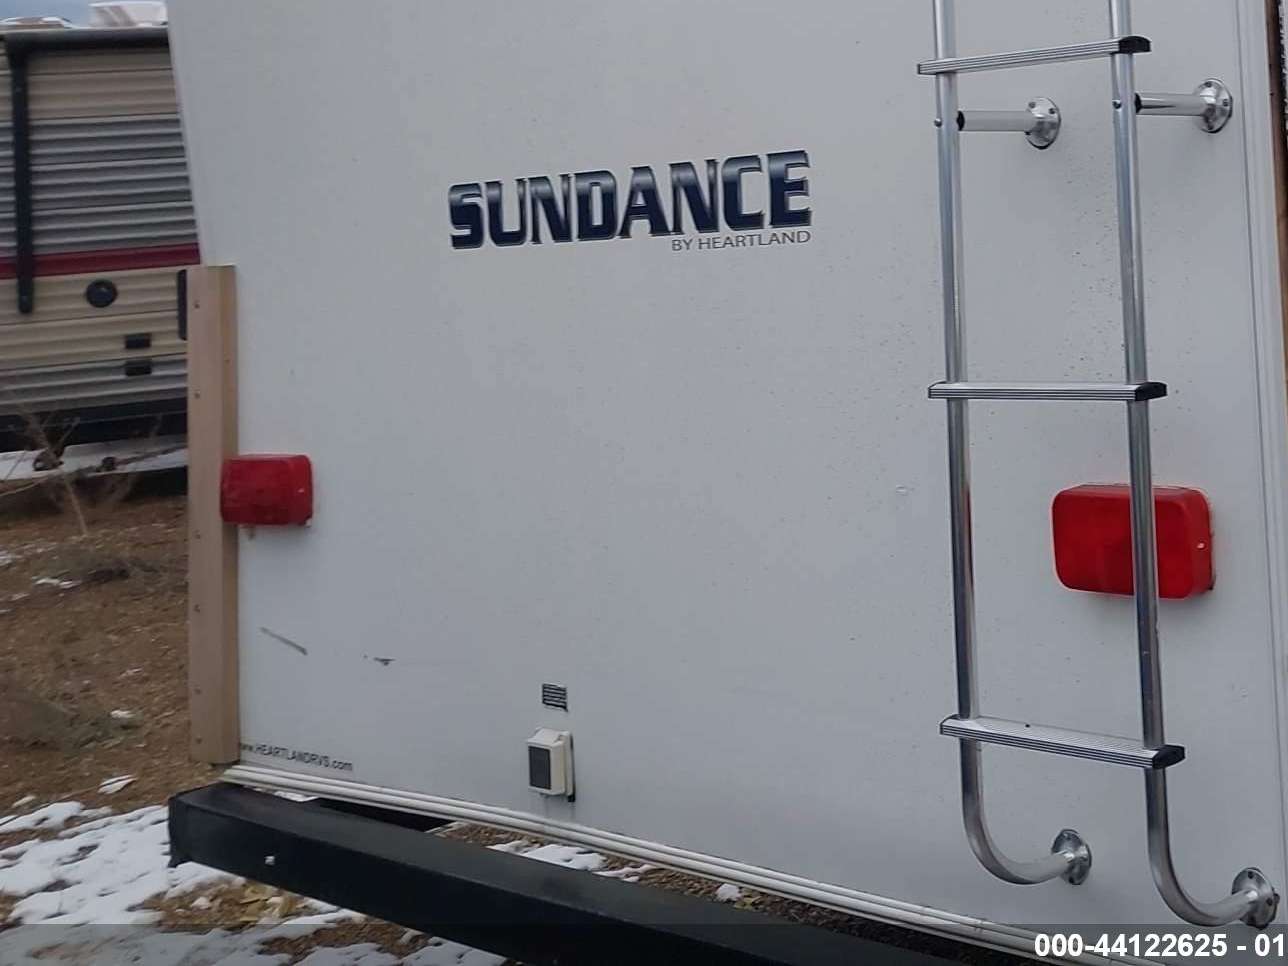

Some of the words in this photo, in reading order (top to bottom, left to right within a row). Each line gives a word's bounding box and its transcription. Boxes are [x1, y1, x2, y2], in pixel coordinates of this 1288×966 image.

[448, 150, 812, 250] SUNDANCE
[671, 238, 693, 251] BY
[698, 230, 811, 250] HEARTLAND
